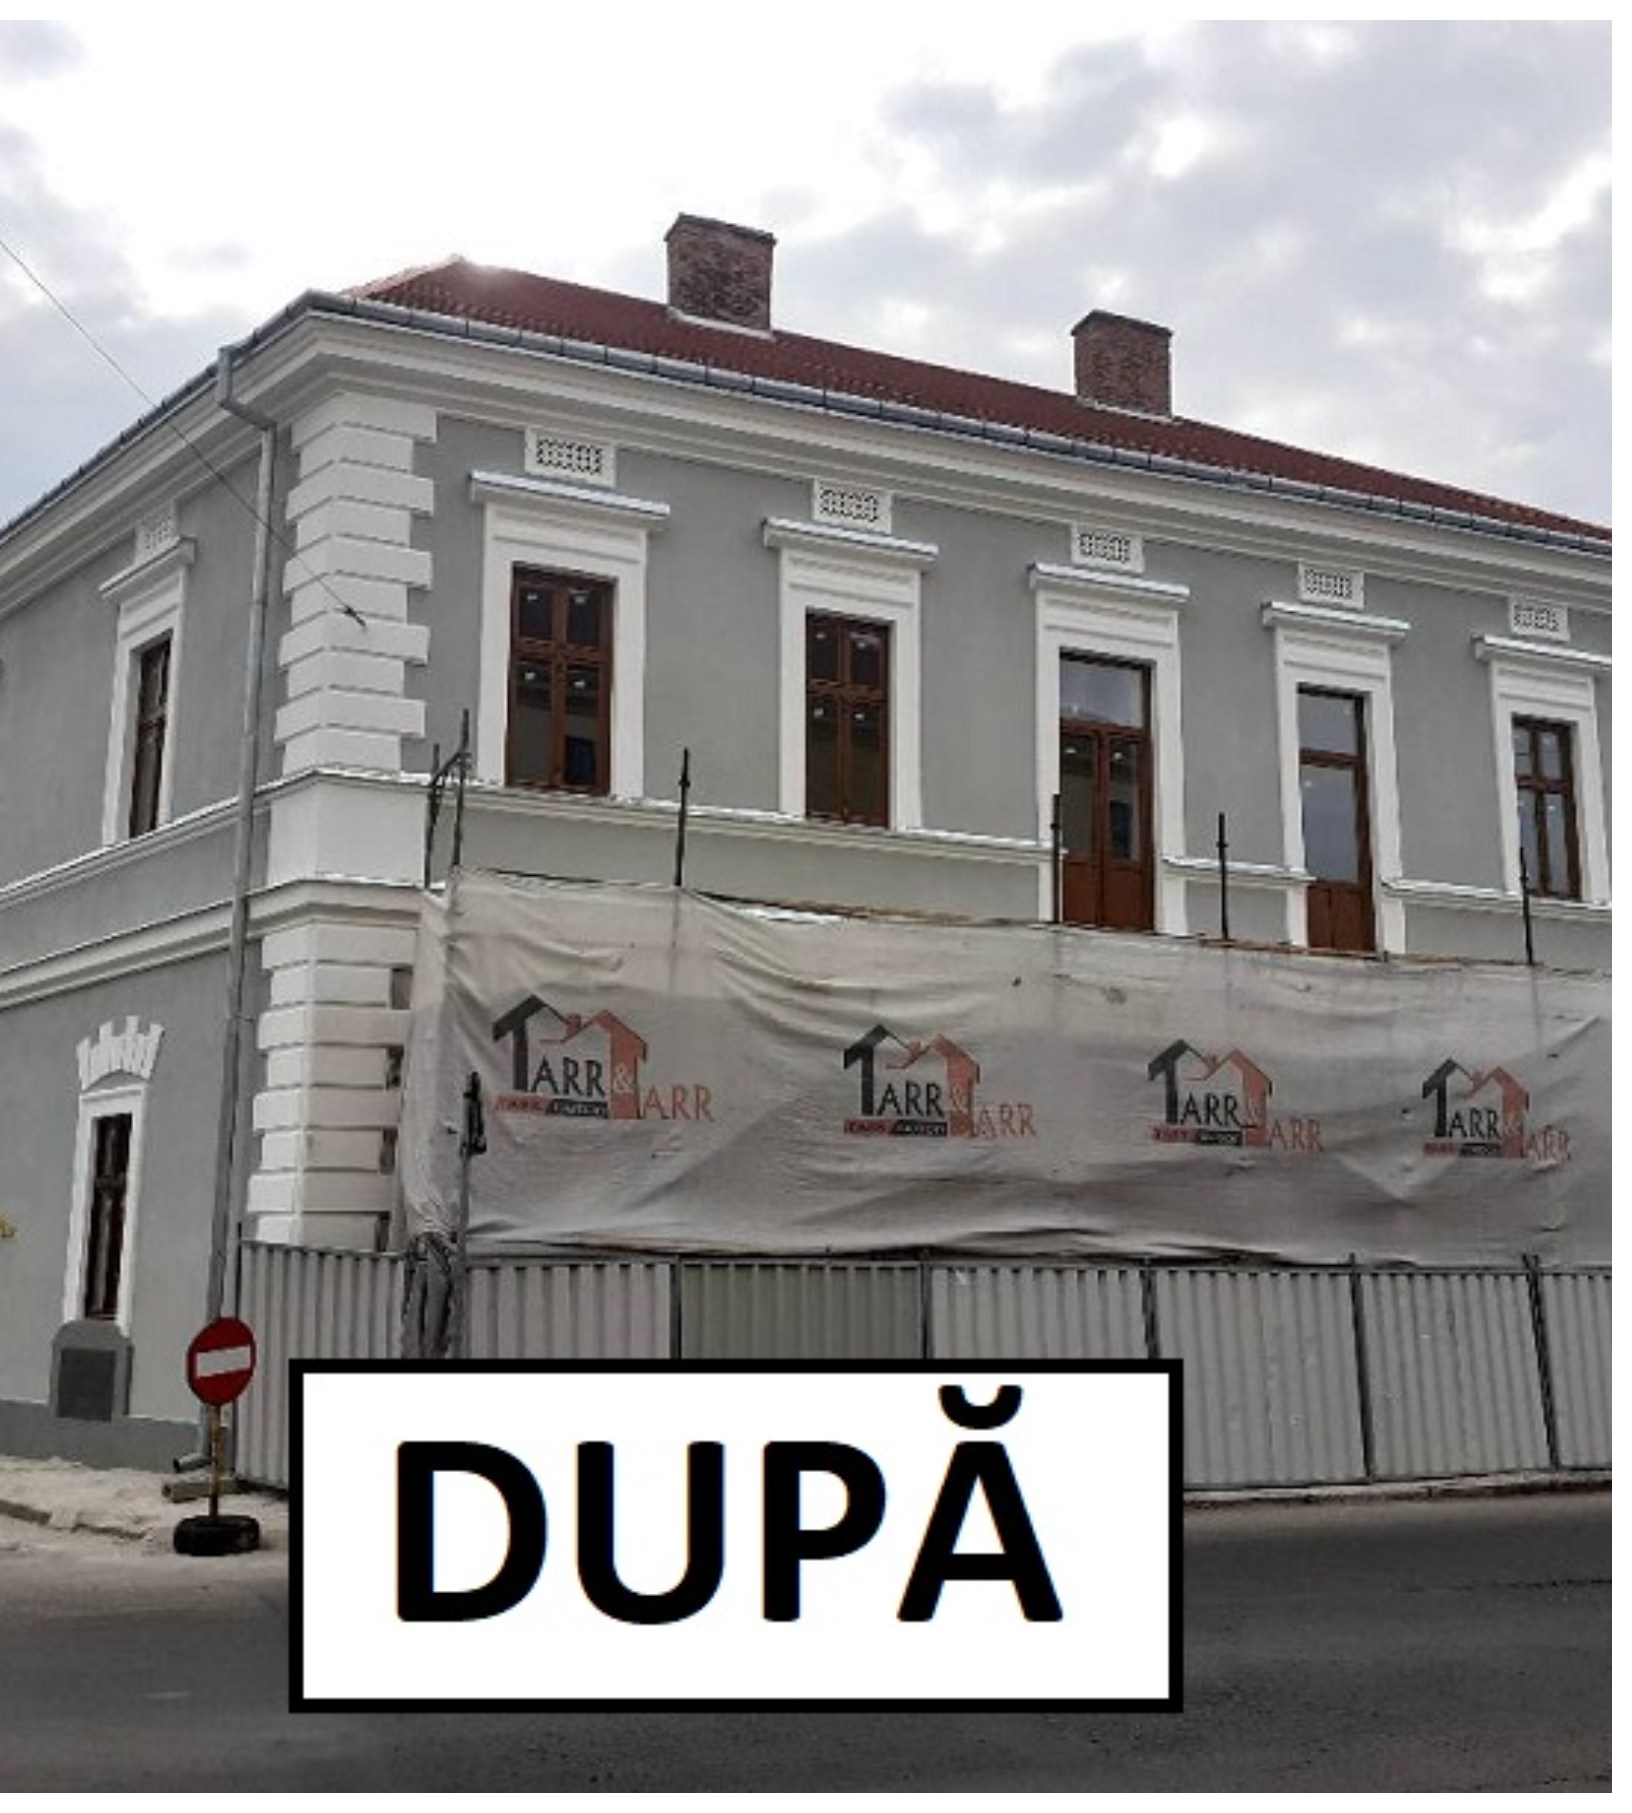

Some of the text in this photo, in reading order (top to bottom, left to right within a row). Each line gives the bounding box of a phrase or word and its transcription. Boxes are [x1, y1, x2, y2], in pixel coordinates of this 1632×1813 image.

[492, 995, 606, 1097] TARR
[843, 1024, 945, 1117] TARR
[1147, 1038, 1241, 1126] TARR
